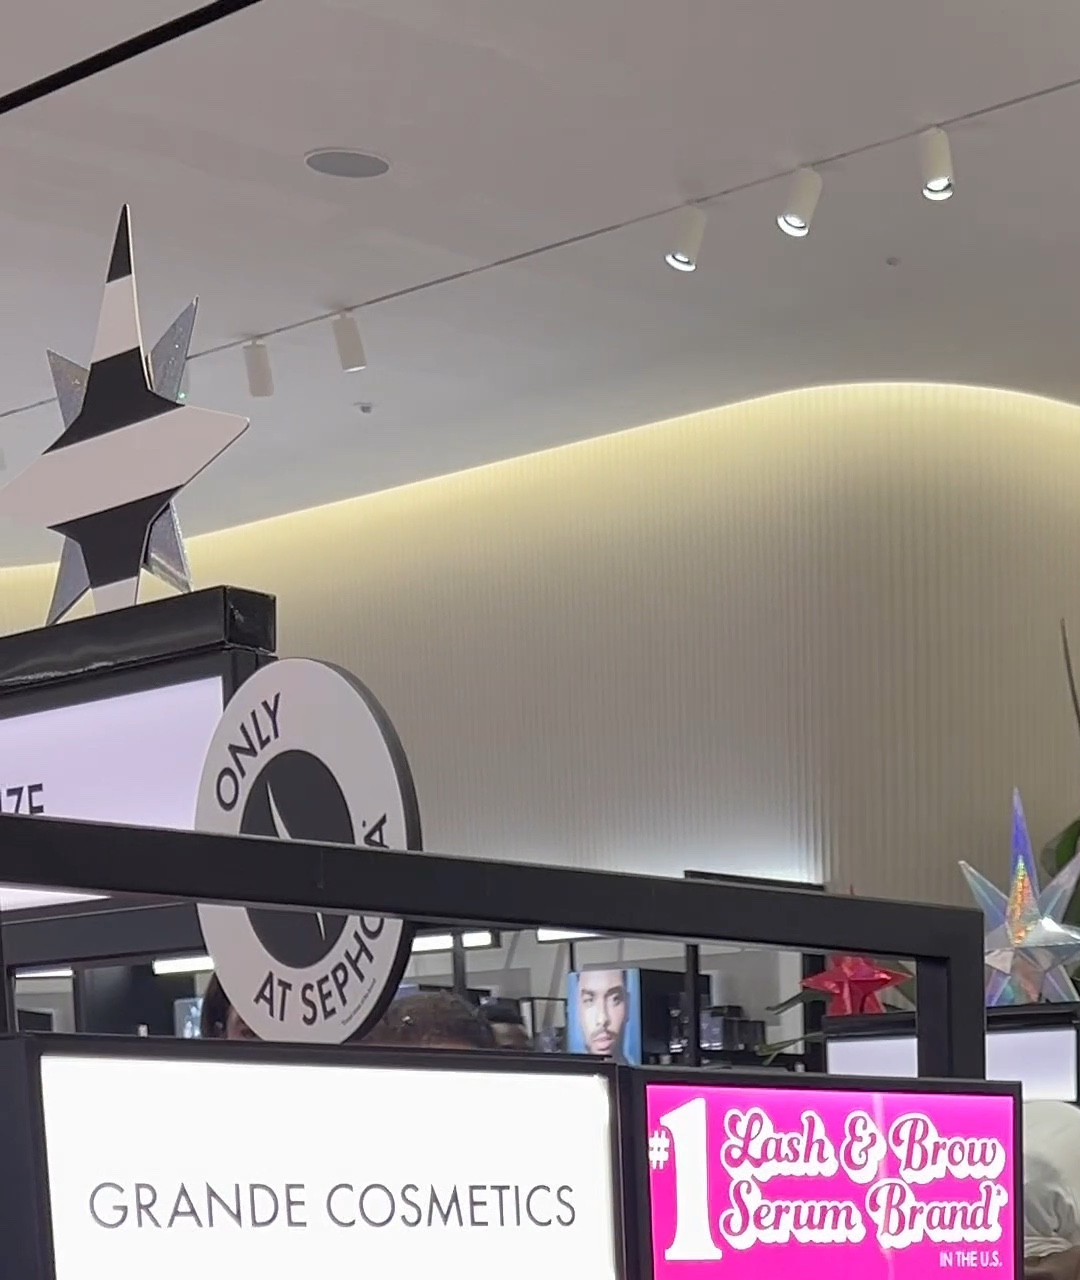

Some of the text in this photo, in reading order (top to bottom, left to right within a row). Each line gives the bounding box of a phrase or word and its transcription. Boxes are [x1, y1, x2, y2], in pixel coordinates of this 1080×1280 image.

[215, 692, 281, 811] ONLY
[253, 971, 292, 1022] AT
[301, 814, 389, 1026] SEPHOA
[89, 1182, 577, 1230] GRANDE COSMETICS
[649, 1097, 1001, 1261] #1 Lash & Brow
[721, 1179, 862, 1244] Serum
[940, 1251, 1003, 1267] IN THE U.S.
